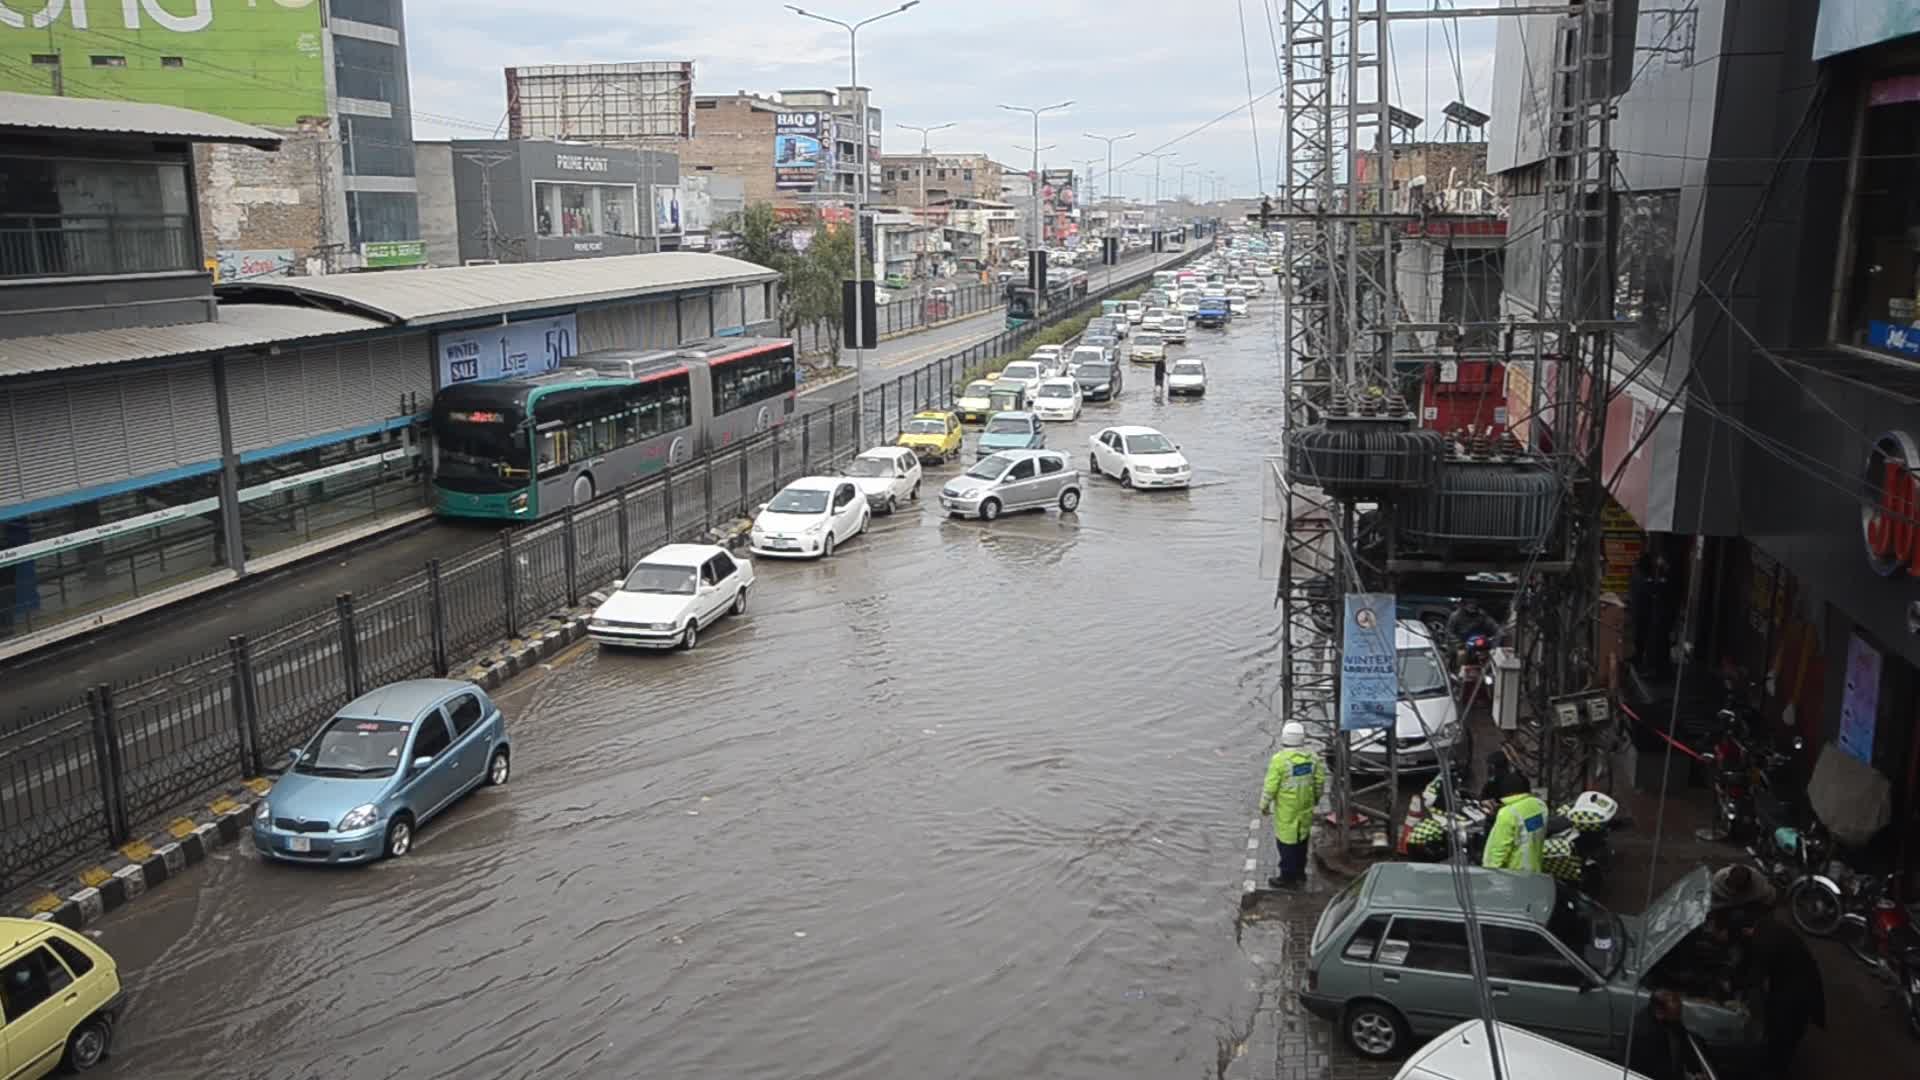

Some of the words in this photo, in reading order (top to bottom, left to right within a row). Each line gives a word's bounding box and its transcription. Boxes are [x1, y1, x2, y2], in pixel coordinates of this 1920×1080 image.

[777, 113, 804, 127] HAQ
[557, 155, 583, 171] PRIME
[584, 156, 608, 172] POINT
[447, 341, 479, 358] WINTER
[545, 329, 570, 369] 50
[452, 361, 477, 380] SALE
